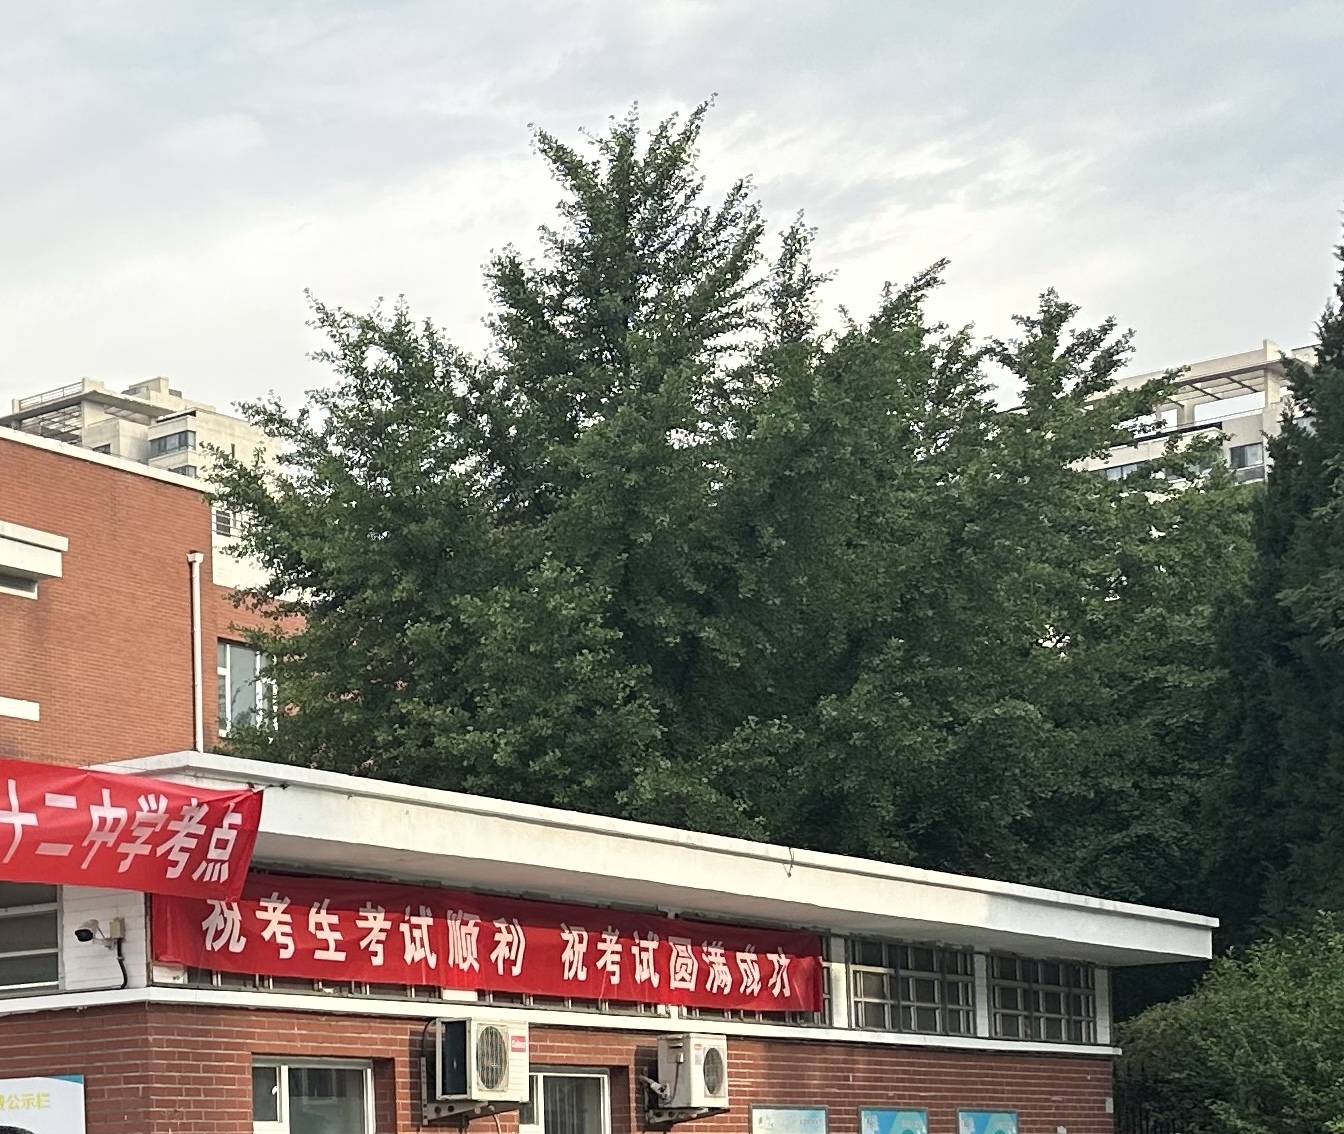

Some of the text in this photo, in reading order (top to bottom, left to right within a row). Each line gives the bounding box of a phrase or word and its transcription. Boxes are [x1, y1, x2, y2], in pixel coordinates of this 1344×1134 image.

[202, 890, 792, 999] 祝考生考试顺利 祝考试圆满成功
